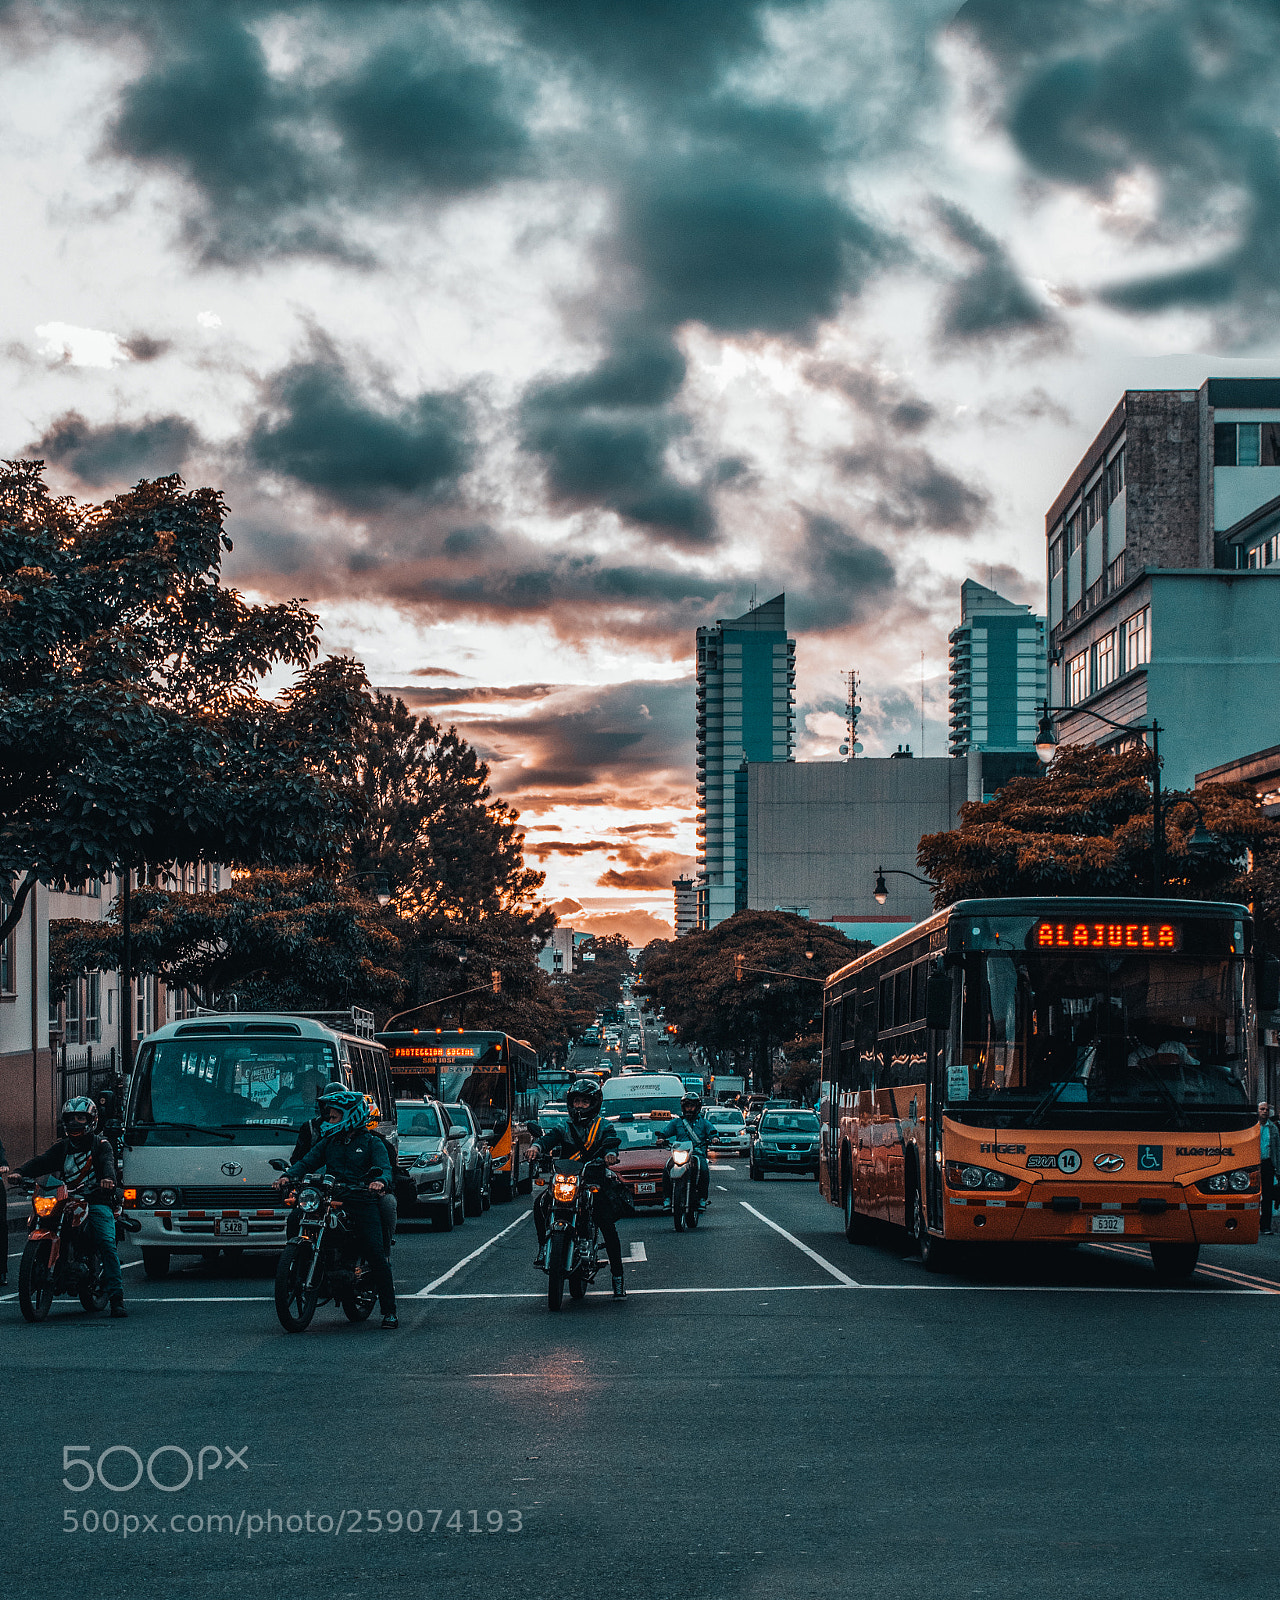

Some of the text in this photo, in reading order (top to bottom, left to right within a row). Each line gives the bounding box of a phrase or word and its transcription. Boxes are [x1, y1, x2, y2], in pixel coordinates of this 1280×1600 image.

[980, 1143, 1027, 1154] HIGER
[1061, 1155, 1076, 1168] 14
[224, 1223, 242, 1232] 5428
[1098, 1219, 1118, 1230] 6302
